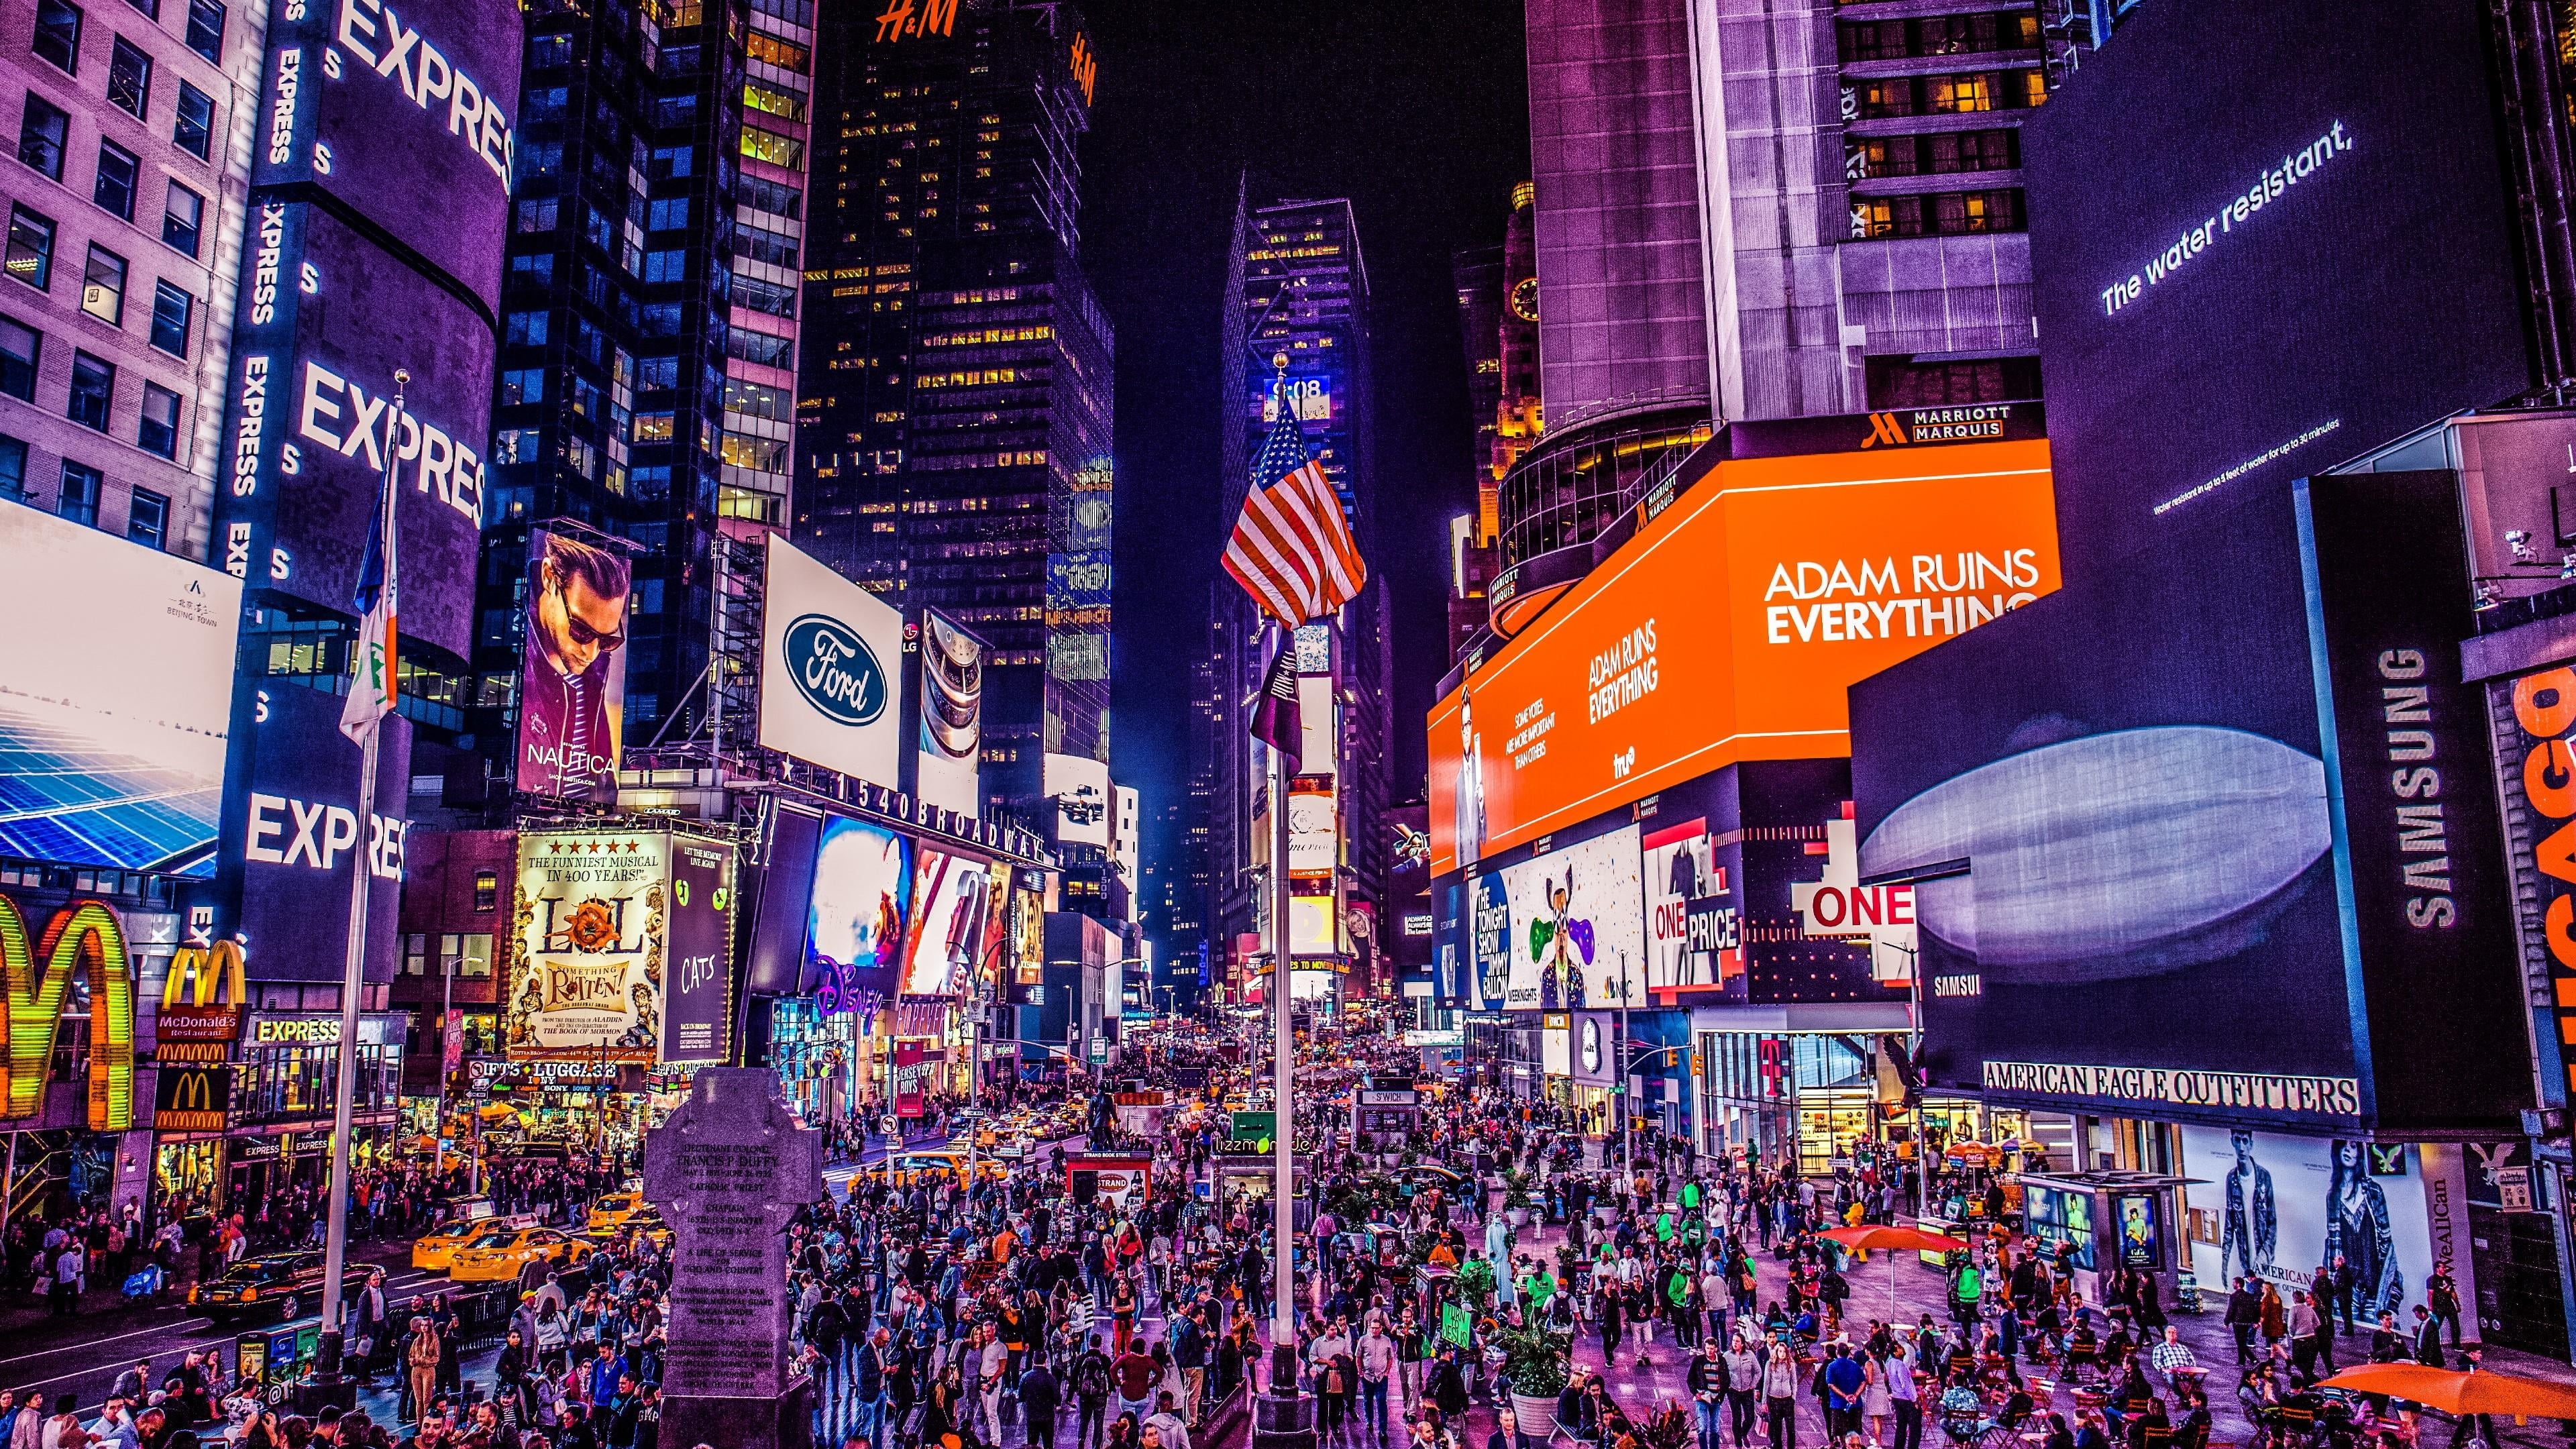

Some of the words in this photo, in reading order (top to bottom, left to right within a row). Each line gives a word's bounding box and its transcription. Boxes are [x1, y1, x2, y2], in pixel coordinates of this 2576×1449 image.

[877, 0, 959, 42] H&M
[1071, 32, 1095, 107] H&M
[270, 49, 300, 164] EXPRESS
[2101, 274, 2141, 315] The
[2144, 217, 2216, 285] water
[2221, 119, 2353, 233] resistant,
[233, 356, 269, 496] EXPRESS
[1914, 405, 2010, 425] MARRIOTT
[1915, 422, 2001, 440] MARQUIS
[2226, 468, 2241, 481] feet
[2247, 455, 2269, 471] water
[2268, 448, 2280, 460] for
[2279, 443, 2290, 455] up
[2290, 437, 2299, 449] to
[2298, 433, 2309, 444] 30
[2308, 418, 2340, 440] minutes
[1648, 474, 1677, 506] MARRIOTT
[1648, 490, 1674, 521] MARQUIS
[1764, 555, 1901, 602] ADAM
[1912, 548, 2039, 594] RUINS
[197, 615, 217, 628] TOWN
[901, 640, 918, 653] LG
[1589, 641, 1621, 692] ADAM
[1622, 617, 1656, 669] RUINS
[805, 629, 870, 712] Ford
[1589, 655, 1658, 725] EVERYTHING
[1515, 710, 1529, 730] SOME
[1527, 698, 1544, 720] VOTES
[1506, 737, 1515, 756] ARE
[1514, 729, 1529, 750] MORE
[1527, 712, 1555, 743] IMPORTANT
[527, 743, 618, 776] NAUTICA
[1514, 751, 1528, 770] THAN
[1528, 740, 1546, 765] OTHERS
[563, 775, 596, 787] NAUTICA.COM
[2378, 647, 2456, 930] SAMSUNG
[837, 773, 908, 819] 1540
[918, 798, 1043, 862] BROADWAY
[529, 857, 550, 868] THE
[552, 857, 606, 868] FUNNIEST
[609, 855, 659, 867] MUSICAL
[684, 847, 693, 855] LET
[693, 848, 703, 857] THE
[703, 851, 722, 861] MEMORY
[690, 857, 701, 867] LIVE
[701, 860, 716, 869] AGAIN
[547, 869, 562, 882] IN
[565, 870, 590, 882] 400
[1478, 886, 1490, 910] THE
[1813, 885, 1915, 927] ONE
[948, 870, 992, 965] 21
[1478, 905, 1507, 934] TONIGHT
[1656, 902, 1685, 941] ONE
[1478, 930, 1499, 955] SHOW
[1688, 908, 1737, 953] PRICE
[557, 966, 617, 975] SOMETHING
[681, 954, 715, 995] CATS
[1487, 949, 1509, 977] JIMMY
[1483, 975, 1509, 1000] FALLON
[159, 1015, 236, 1028] McDonald's
[258, 1020, 341, 1042] EXPRESS
[895, 1002, 947, 1036] FOREVER
[897, 1065, 922, 1082] JERSEY
[900, 1079, 918, 1095] BOYS
[1984, 1061, 2088, 1094] AMERICAN
[2094, 1067, 2168, 1101] EAGLE
[2174, 1072, 2359, 1116] OUTFITTERS
[246, 1144, 280, 1157] EXPRESS
[296, 1140, 328, 1151] EXPRESS
[733, 1144, 770, 1154] COLONEL
[676, 1155, 724, 1167] FRANCIS
[739, 1156, 780, 1167] DUFFY
[688, 1183, 729, 1191] CATHOLIC
[734, 1183, 765, 1192] PRIEST
[1097, 1179, 1126, 1187] STRAND
[705, 1204, 745, 1212] CHAPLAIN
[727, 1216, 763, 1225] INFANTRY
[696, 1249, 713, 1257] LIFE
[715, 1249, 728, 1257] OF
[729, 1250, 763, 1258] SERVICE
[683, 1265, 702, 1273] GOD
[724, 1266, 764, 1275] COUNTRY
[2253, 1263, 2313, 1285] AMERICAN
[1446, 1305, 1466, 1323] TURN
[1451, 1318, 1459, 1330] TO
[1442, 1324, 1469, 1348] JESUS
